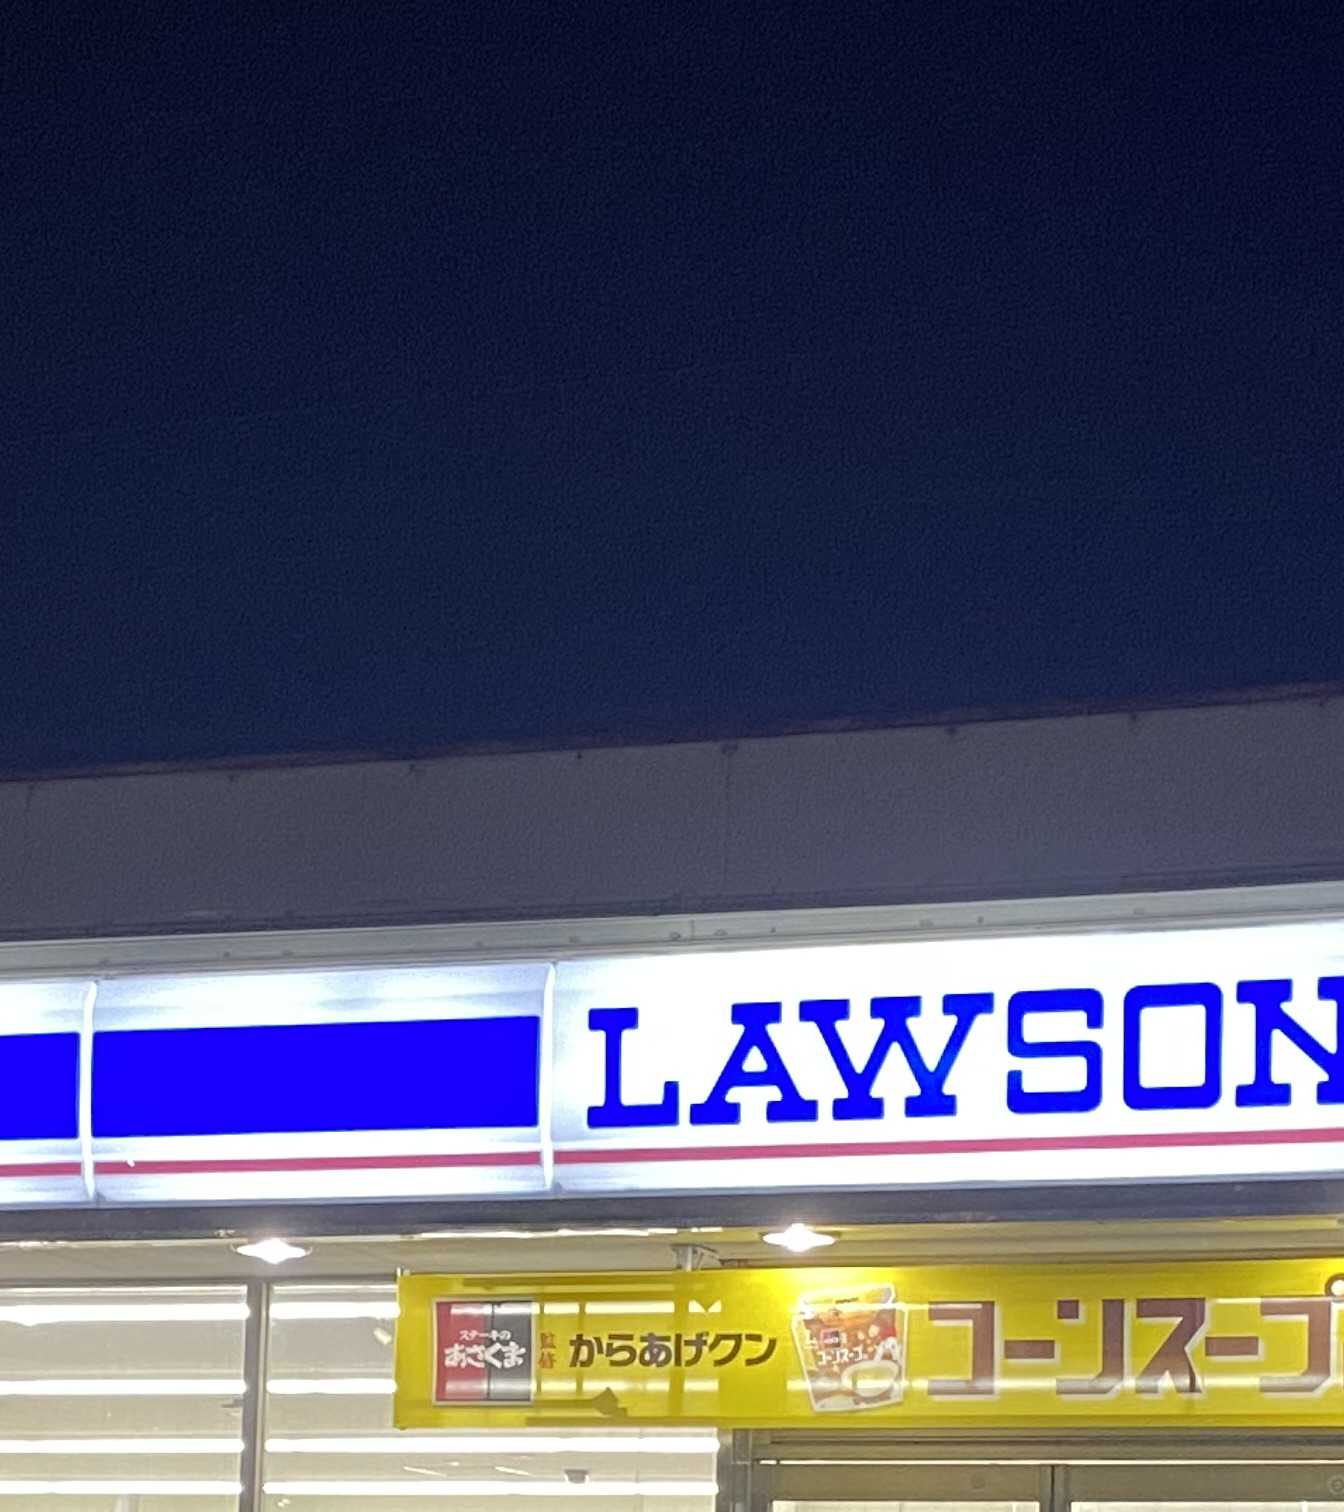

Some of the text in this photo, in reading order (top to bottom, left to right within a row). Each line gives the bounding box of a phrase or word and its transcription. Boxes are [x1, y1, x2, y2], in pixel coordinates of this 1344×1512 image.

[459, 1329, 512, 1342] ステーキの
[444, 1342, 525, 1369] あさくま
[568, 1331, 777, 1369] からあげクン
